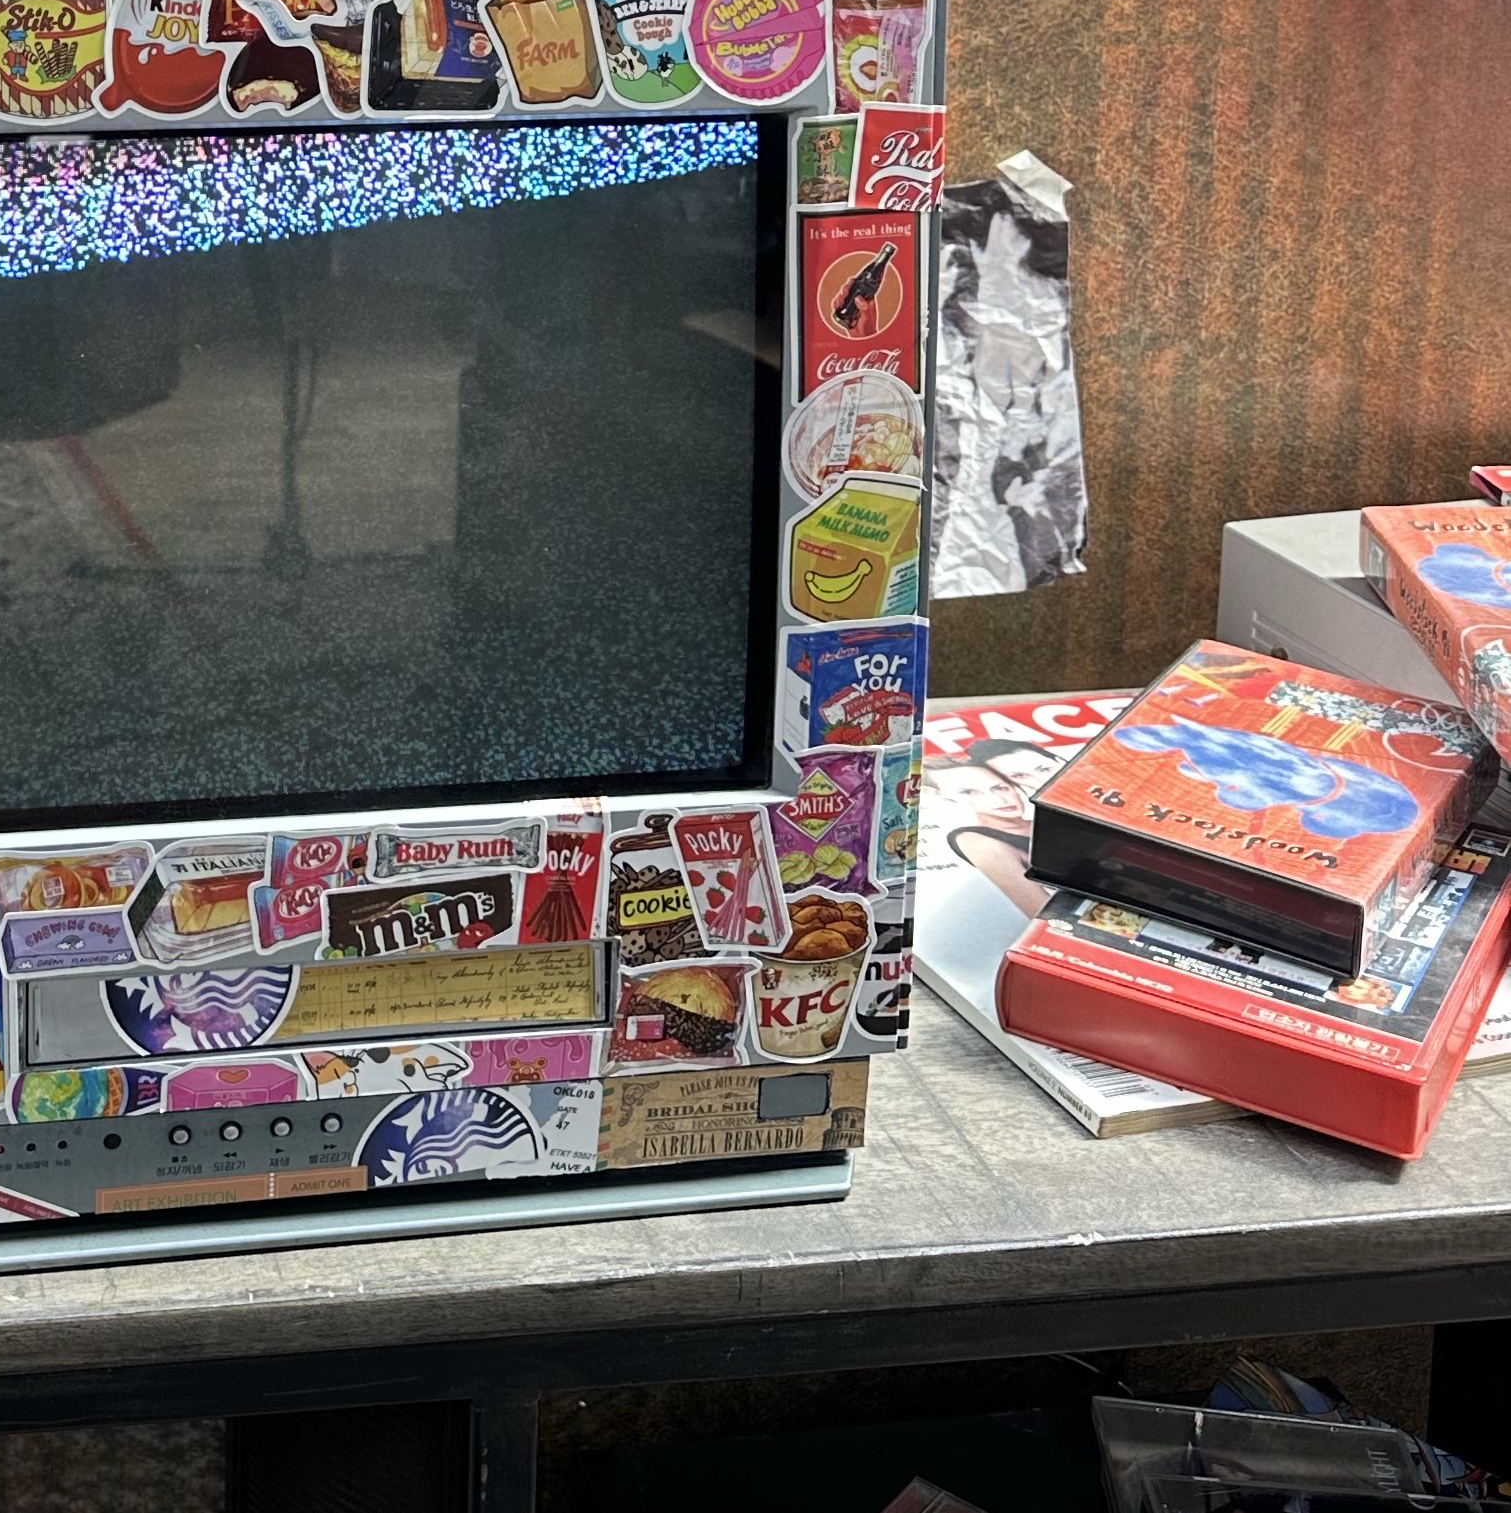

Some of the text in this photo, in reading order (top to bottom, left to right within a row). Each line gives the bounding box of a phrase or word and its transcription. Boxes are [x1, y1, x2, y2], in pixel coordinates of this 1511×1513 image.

[6, 3, 76, 32] Stik-O
[146, 15, 200, 43] JOY
[633, 17, 674, 31] Cookie
[637, 29, 673, 42] Dough
[516, 38, 580, 71] FARM
[808, 223, 912, 240] It's the real thing
[838, 503, 888, 526] BANANA
[818, 515, 891, 543] MILK MEMO
[788, 795, 845, 816] SMITH'S
[396, 838, 516, 864] Baby Ruth
[24, 918, 85, 948] CHEWING
[759, 980, 850, 1028] KFC
[680, 1079, 712, 1098] PLEASE
[646, 1103, 715, 1118] BRIDAL
[642, 1126, 804, 1158] ISABELLA BERNARDO
[155, 1151, 351, 1178] 정지/꺼냄 되감기 재생 빨리감기
[550, 1160, 580, 1173] HAVE
[112, 1177, 352, 1213] ART EXHIBITION ADMIT ONE
